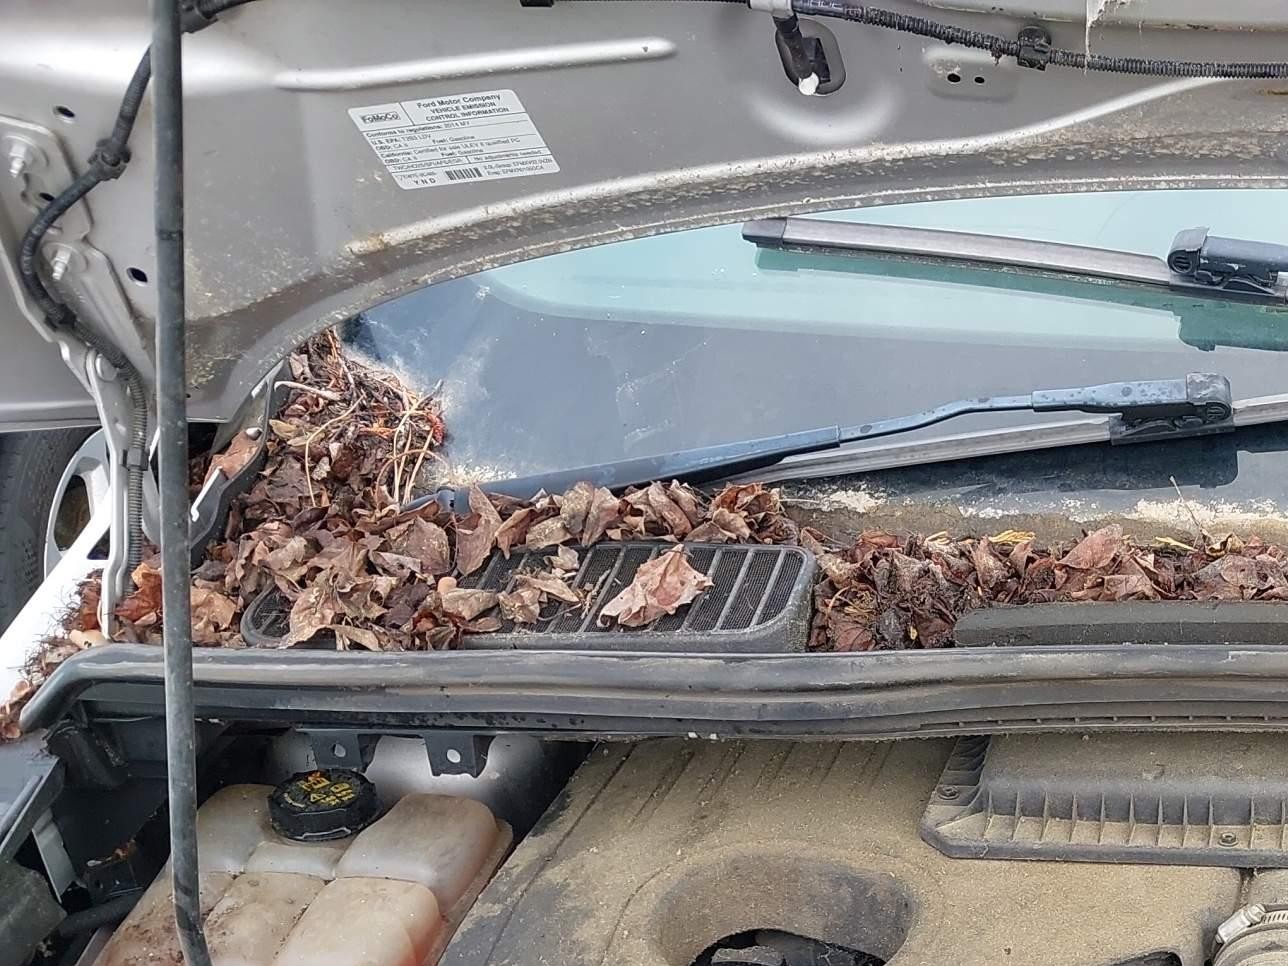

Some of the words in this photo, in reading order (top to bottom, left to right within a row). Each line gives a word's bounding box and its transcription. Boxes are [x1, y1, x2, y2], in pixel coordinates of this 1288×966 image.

[462, 94, 501, 103] Company
[460, 107, 509, 116] INFORMATION
[362, 112, 400, 123] FoMoCo
